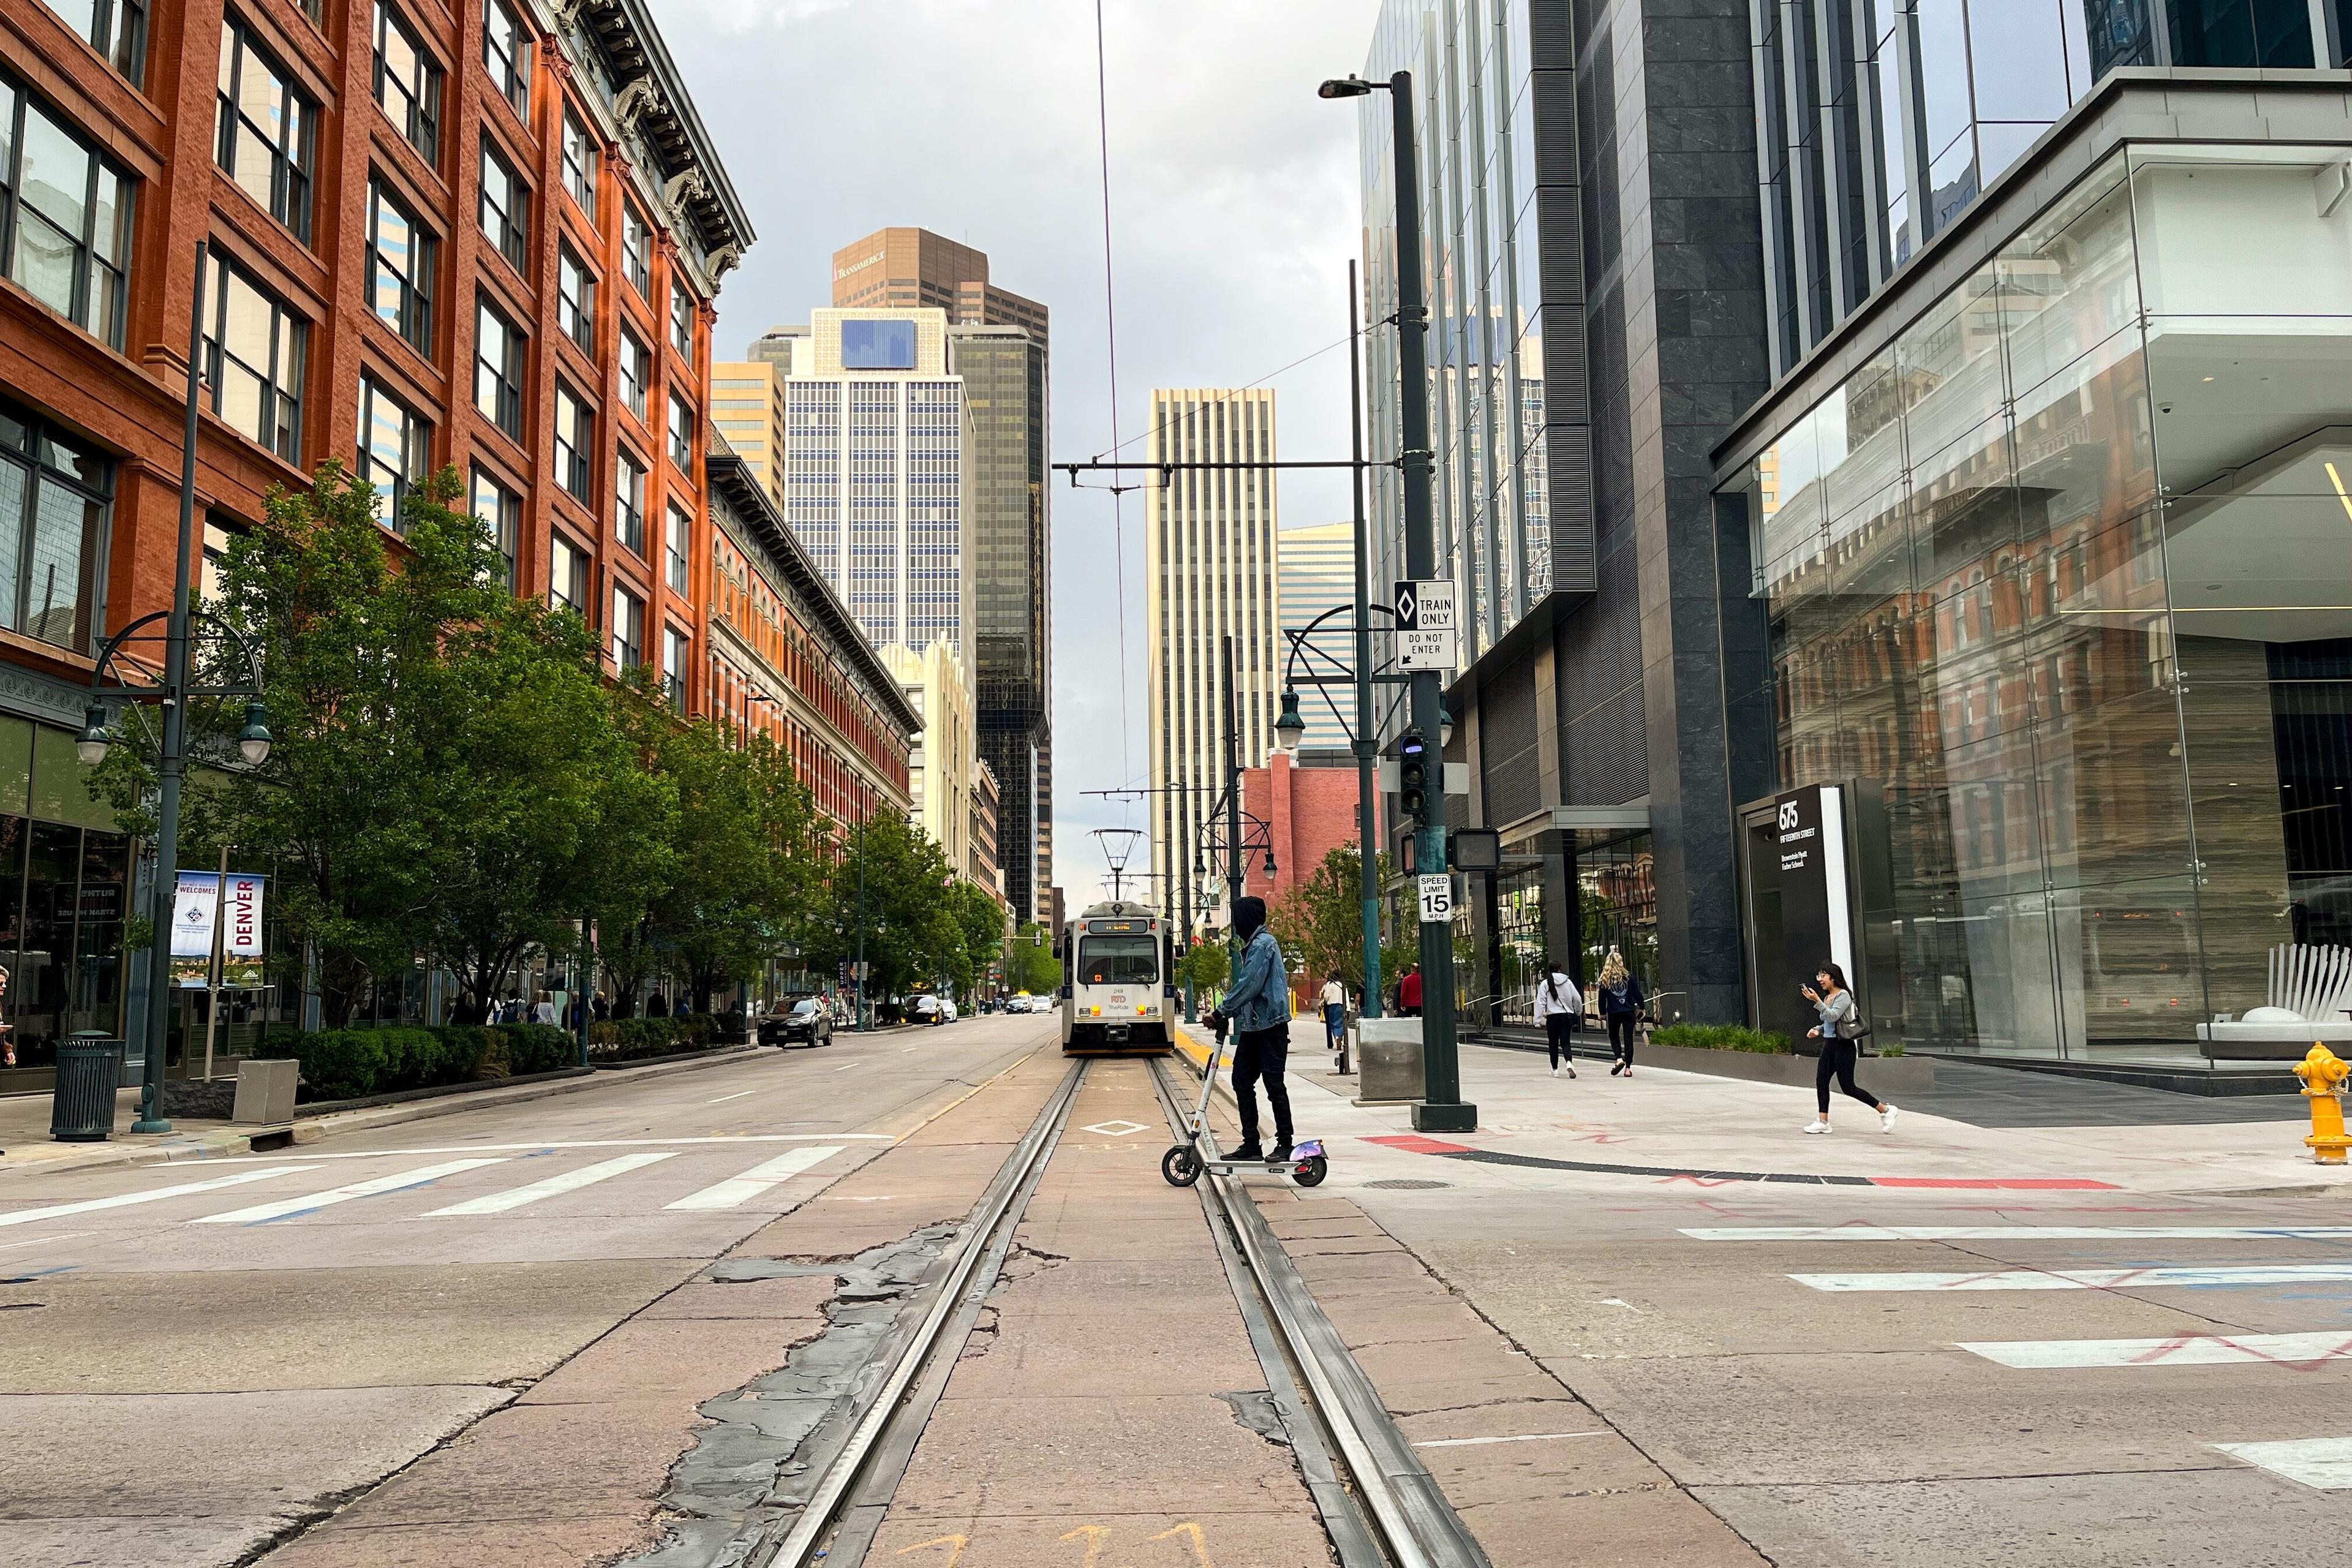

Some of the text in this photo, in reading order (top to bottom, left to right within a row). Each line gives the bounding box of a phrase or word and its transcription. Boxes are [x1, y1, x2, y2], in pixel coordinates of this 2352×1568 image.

[1420, 600, 1451, 610] TRAIN
[1422, 614, 1449, 624] ONLY
[1779, 800, 1798, 830] 675
[1780, 827, 1815, 843] FIFTEENTH STREET
[1422, 895, 1449, 912] 15
[236, 881, 254, 945] DENVER
